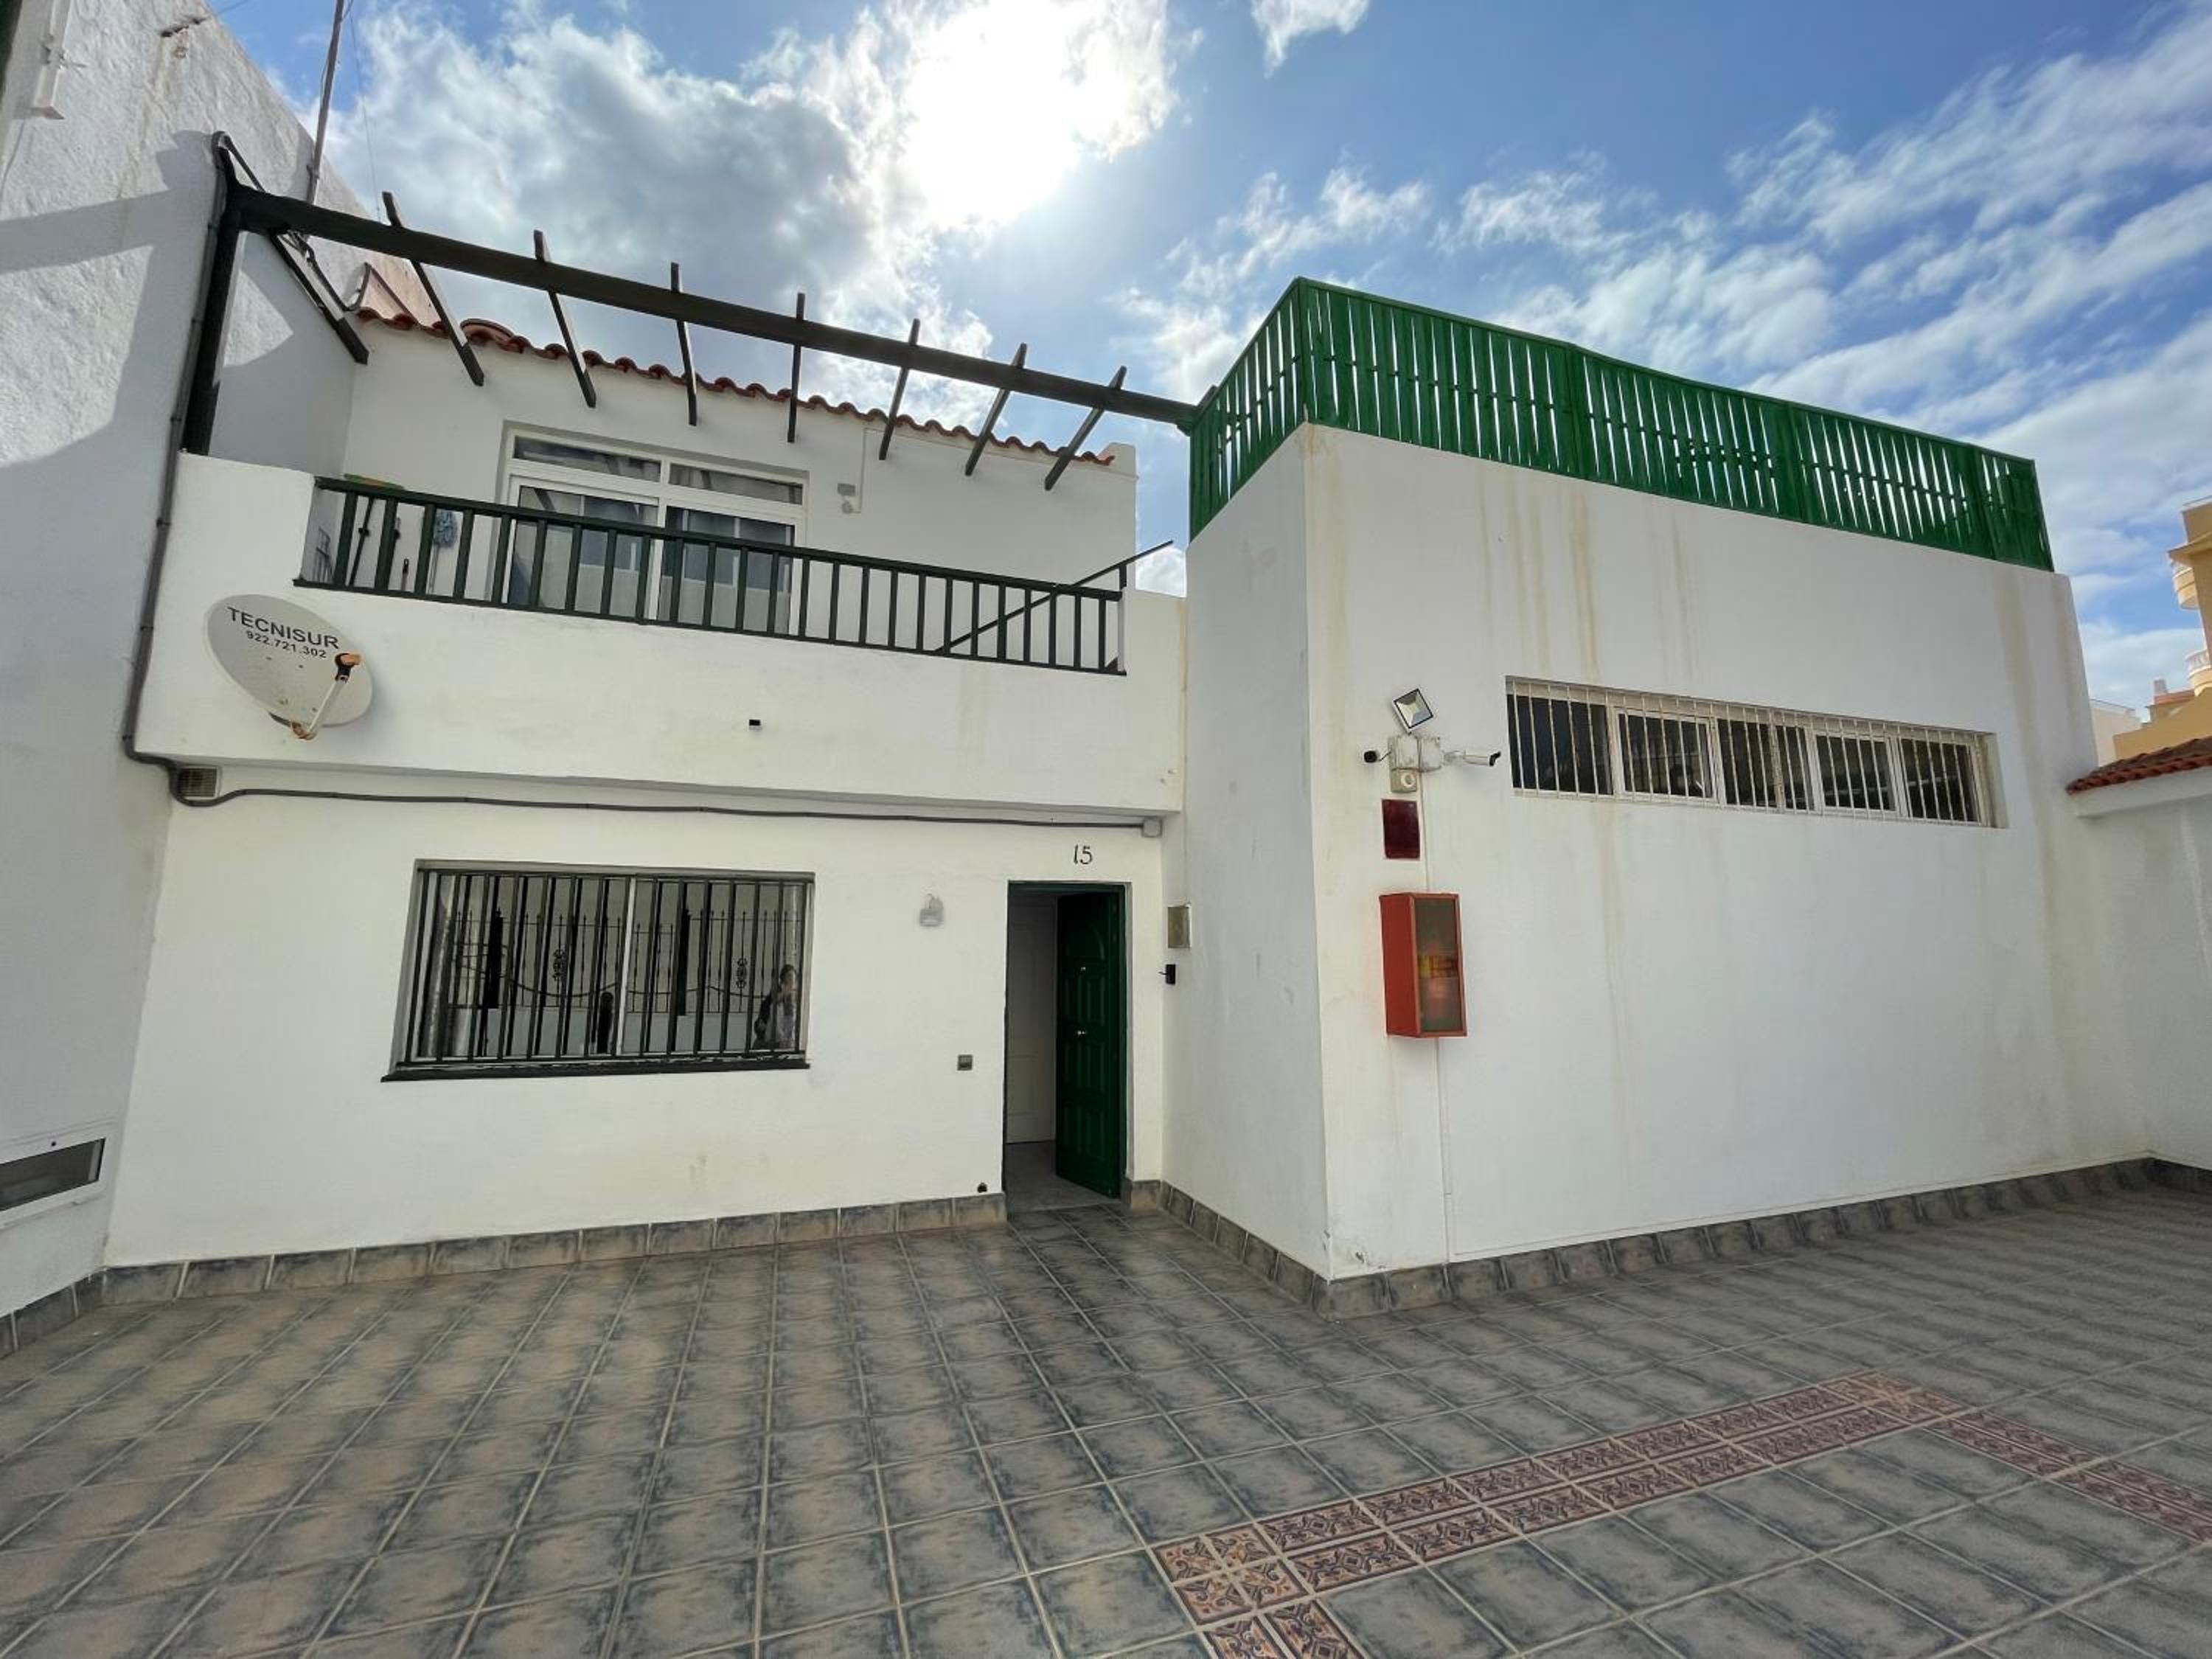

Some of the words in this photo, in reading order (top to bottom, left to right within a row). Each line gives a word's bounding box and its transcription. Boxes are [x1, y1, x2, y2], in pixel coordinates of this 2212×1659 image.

[227, 606, 339, 650] TECNISUR
[246, 630, 327, 658] 922.721.302
[1074, 844, 1093, 865] 15
